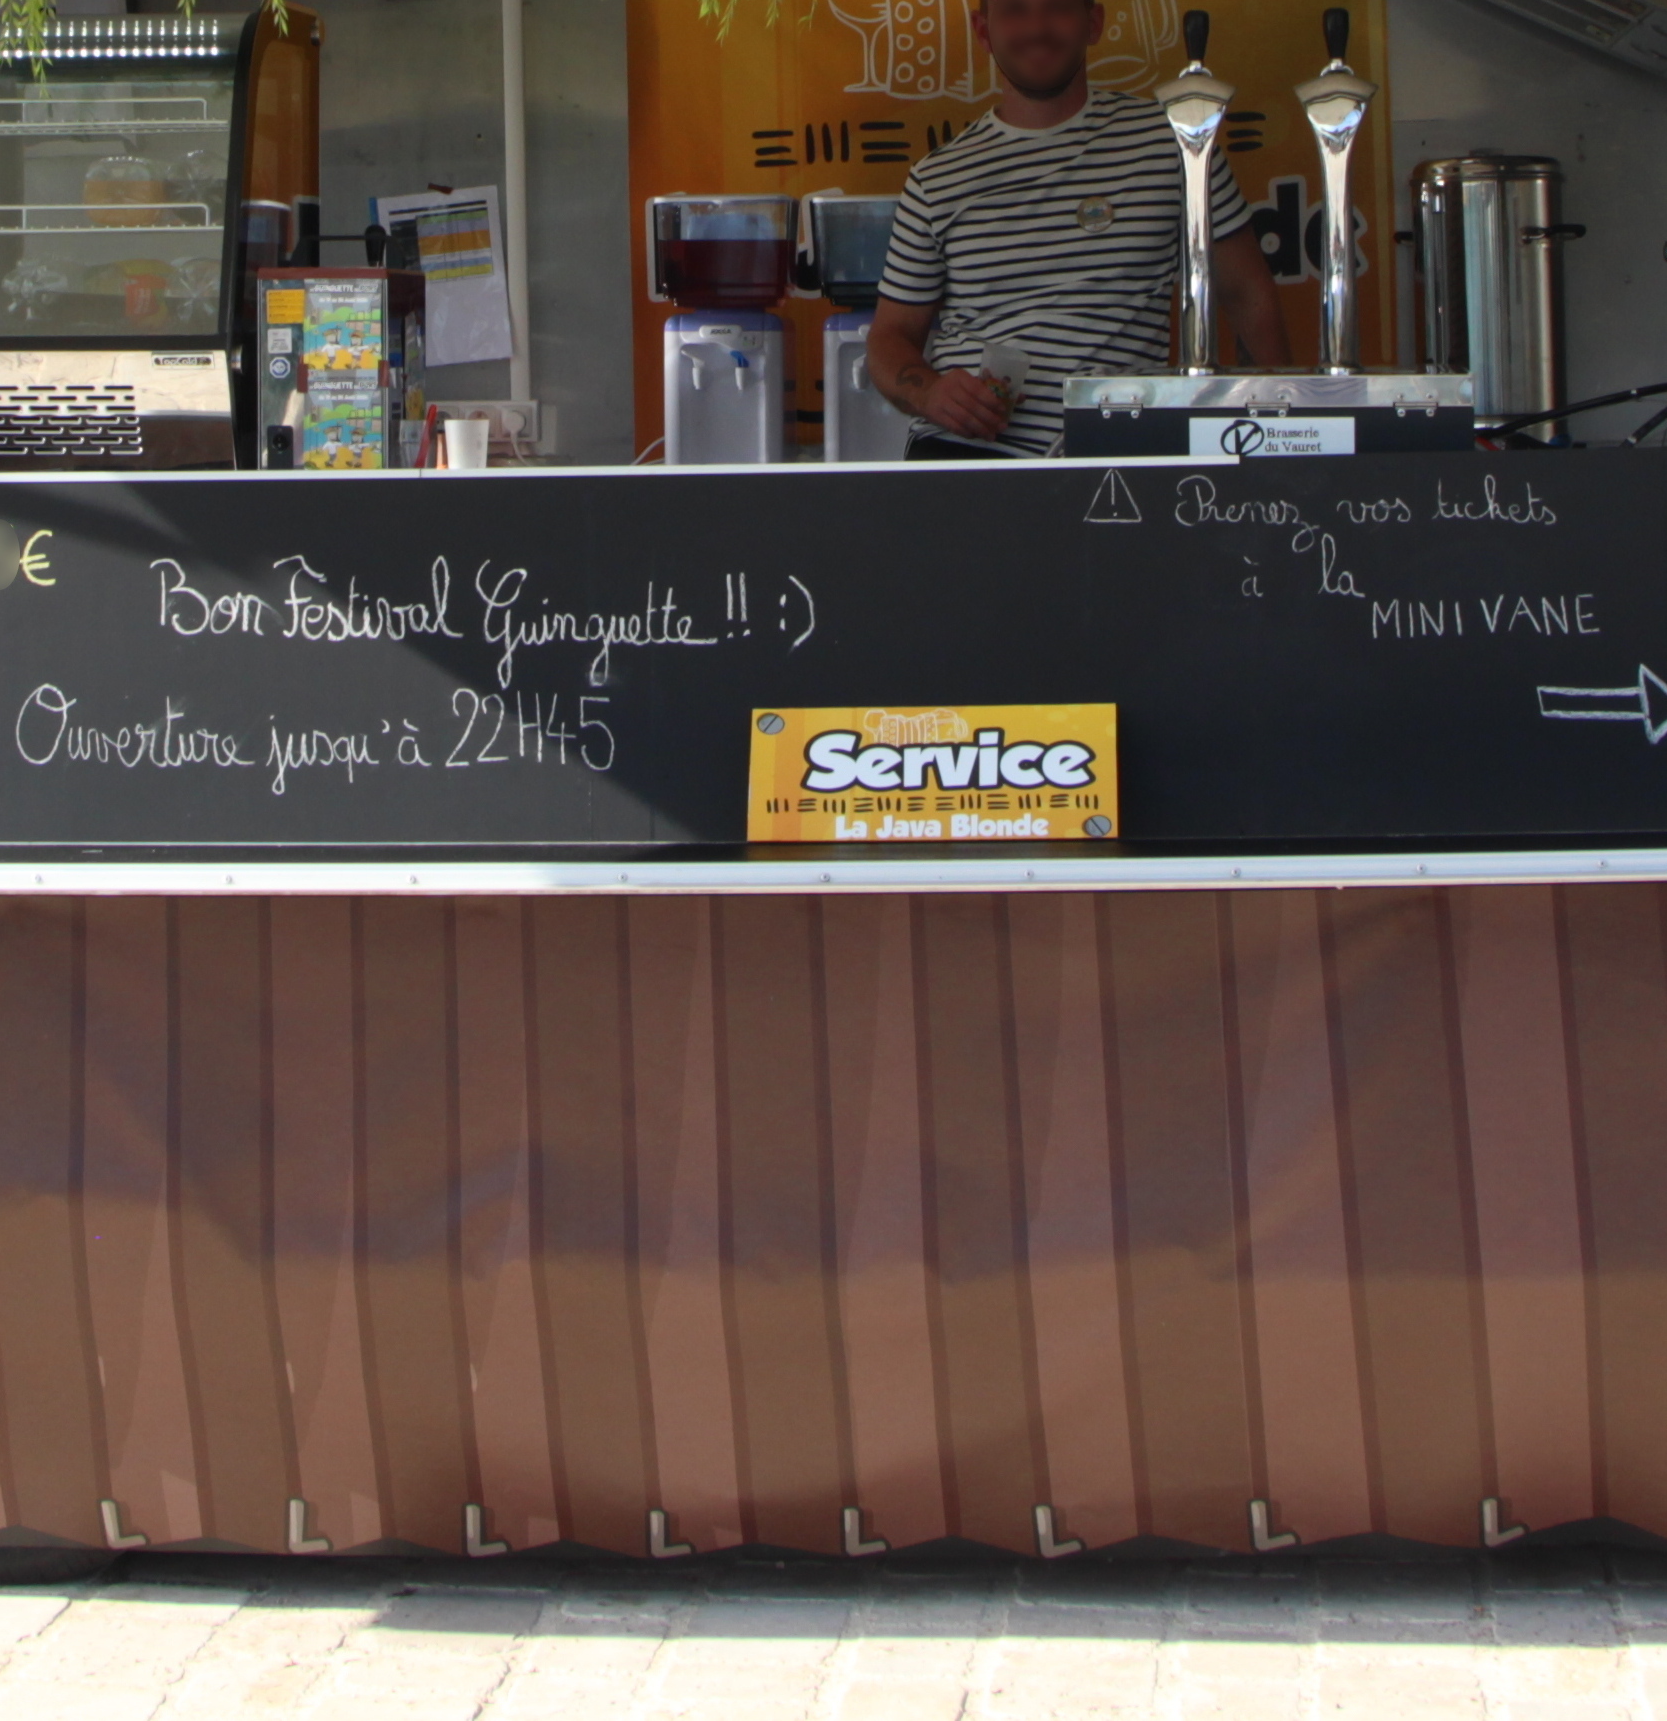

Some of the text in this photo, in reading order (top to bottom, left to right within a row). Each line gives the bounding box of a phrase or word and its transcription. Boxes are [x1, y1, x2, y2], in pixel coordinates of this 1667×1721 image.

[1264, 441, 1322, 453] du Vauret
[1266, 427, 1320, 438] Brasserie
[1175, 474, 1558, 554] Prenez vos tickets
[150, 558, 264, 636] Bon
[273, 555, 464, 642] Festival
[1241, 556, 1263, 599] à
[1319, 534, 1366, 600] la
[15, 683, 256, 769] Ouverture
[445, 687, 615, 772] 22H45
[801, 729, 1096, 791] Service
[835, 812, 1049, 839] La Java Blonde
